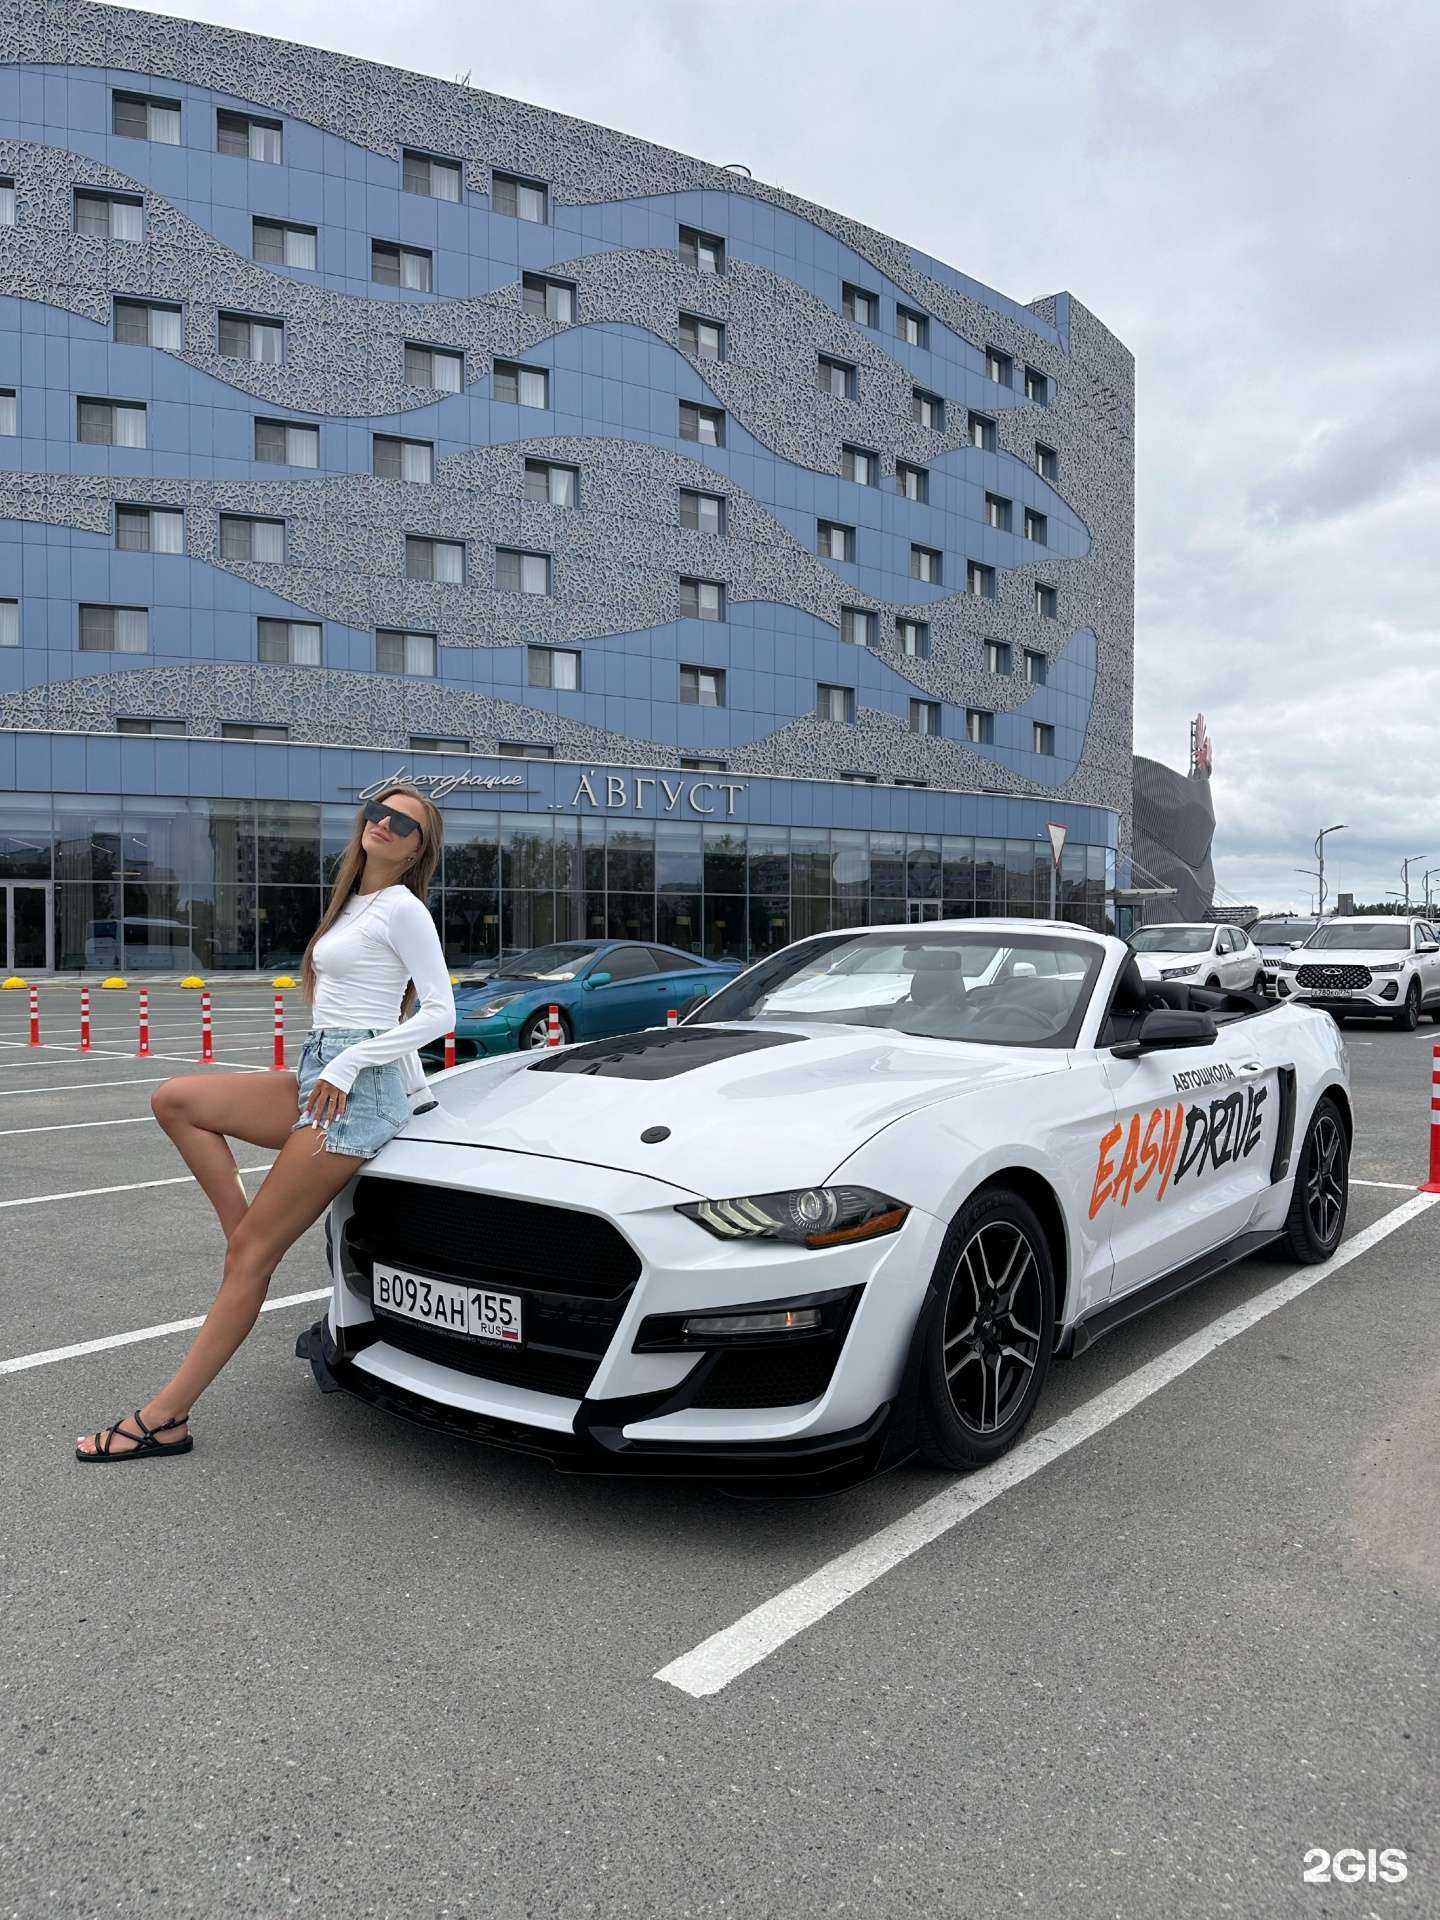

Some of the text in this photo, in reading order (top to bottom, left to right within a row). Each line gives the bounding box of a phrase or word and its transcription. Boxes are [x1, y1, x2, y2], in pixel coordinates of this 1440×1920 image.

[1172, 1062, 1236, 1092] АВТОШКОЛА
[471, 1293, 512, 1326] 155
[480, 1322, 502, 1336] RUS
